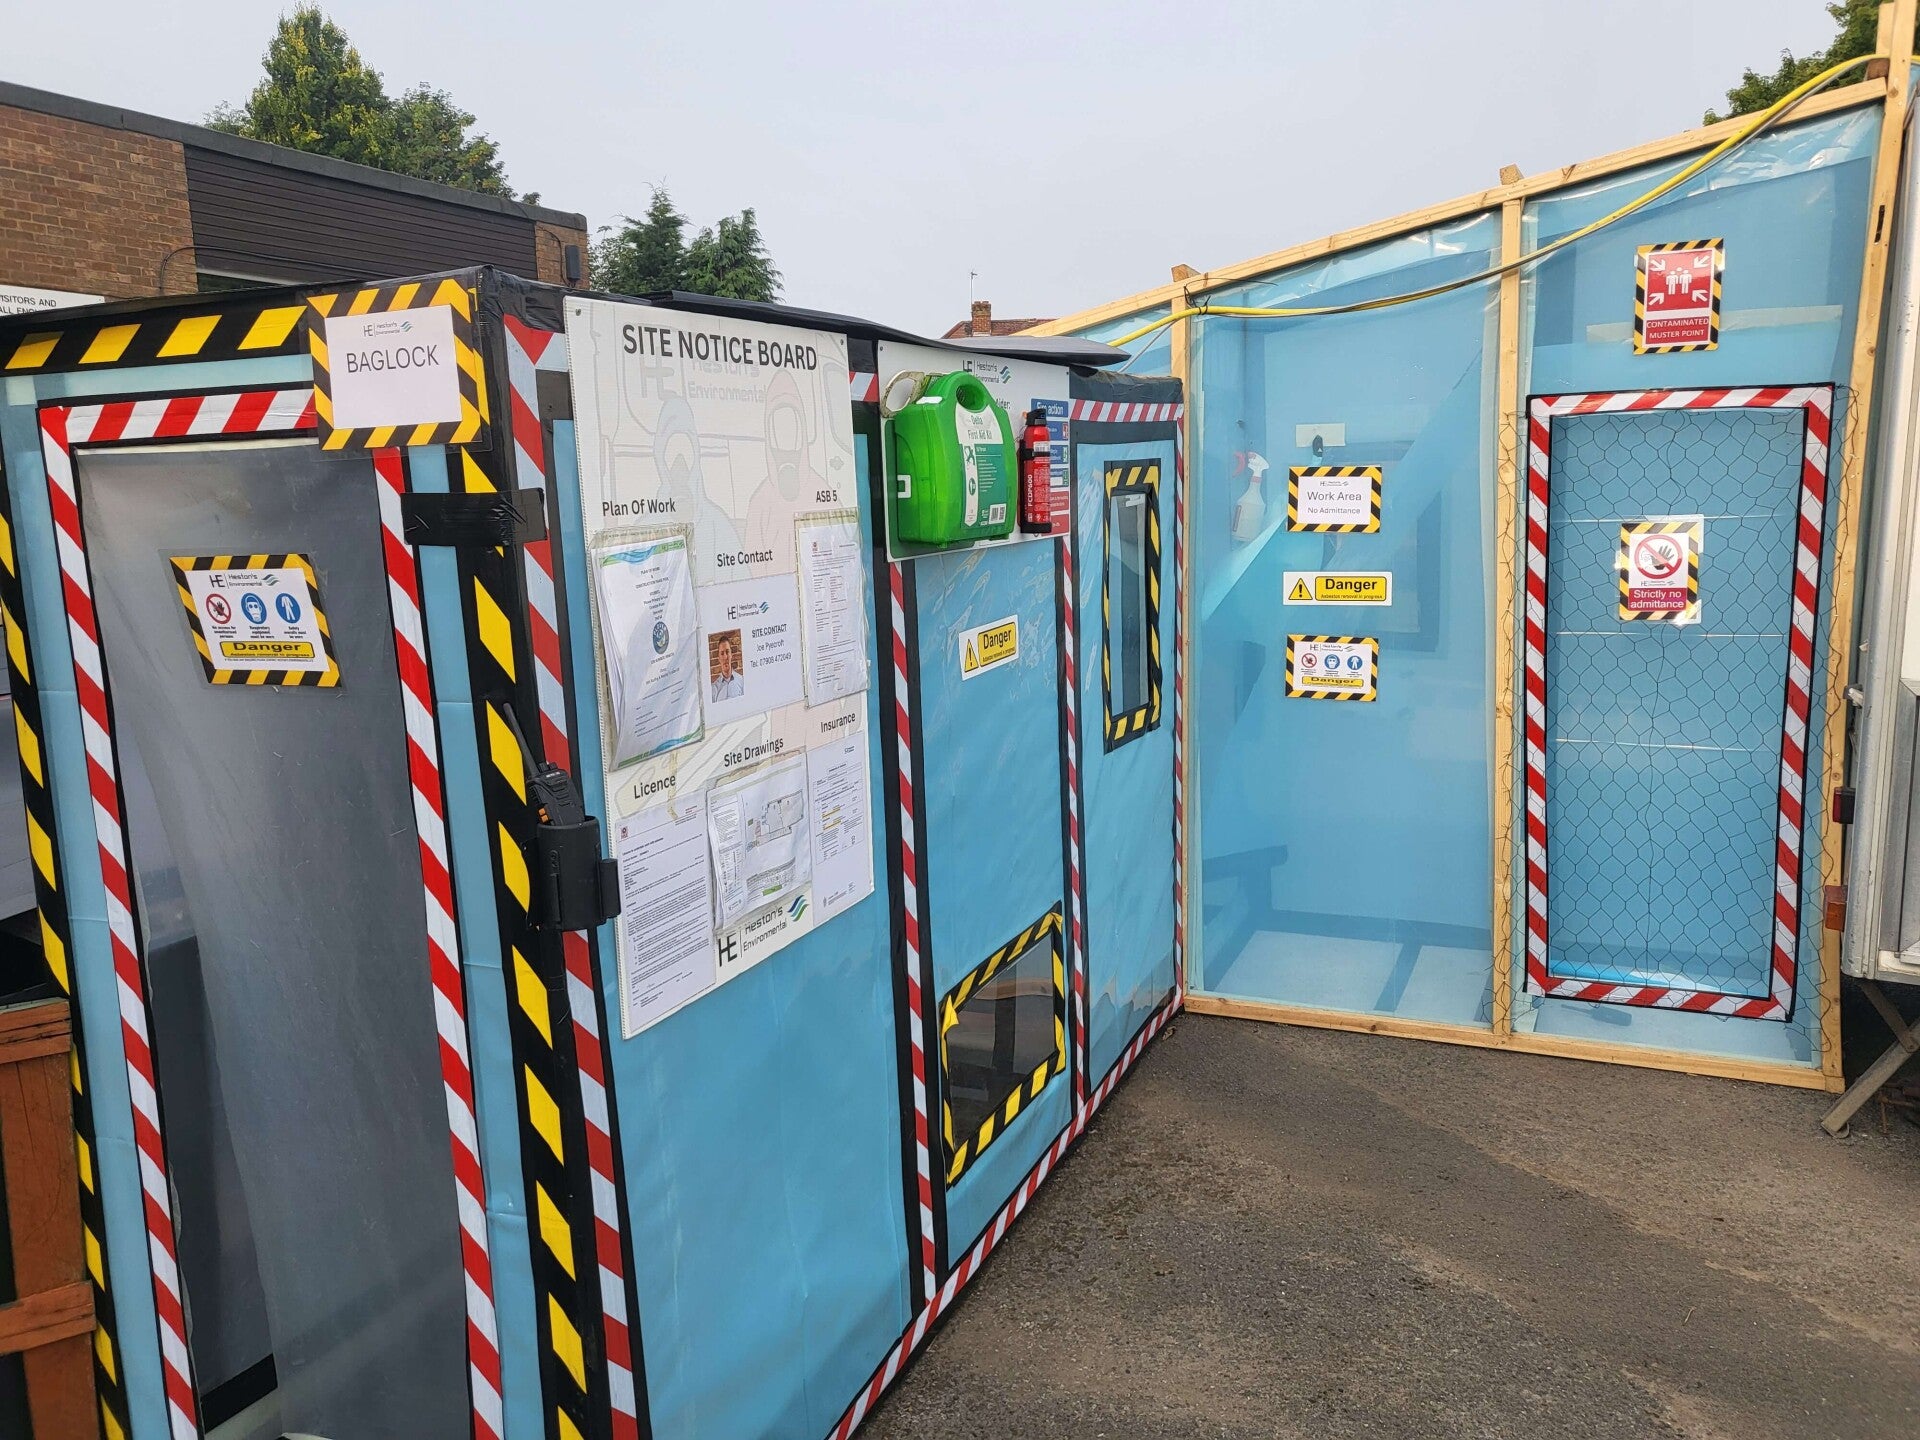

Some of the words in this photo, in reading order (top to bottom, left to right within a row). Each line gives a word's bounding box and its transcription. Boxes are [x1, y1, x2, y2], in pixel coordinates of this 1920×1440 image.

[39, 298, 56, 307] AND
[1646, 318, 1709, 328] CONTAMINATED
[1649, 330, 1680, 338] MUSTER
[622, 324, 673, 357] SITE
[678, 330, 754, 365] NOTICE
[758, 340, 817, 370] BOARD
[346, 344, 439, 373] BAGLOCK
[1048, 404, 1064, 415] action
[816, 490, 832, 503] ASB
[832, 490, 838, 502] 5
[1307, 492, 1334, 500] Work
[1337, 492, 1362, 500] Area
[602, 501, 628, 516] Plan
[632, 500, 645, 514] Of
[648, 498, 676, 514] Work
[717, 553, 736, 567] Site
[738, 549, 773, 564] Contact
[209, 574, 226, 588] HE
[228, 572, 258, 580] Heston's
[1326, 578, 1378, 592] Danger
[1634, 590, 1666, 600] Strictly
[1630, 600, 1684, 609] admittance
[752, 627, 764, 638] SITE
[764, 624, 787, 636] CONTACT
[234, 642, 300, 652] Danger
[983, 630, 1012, 650] Danger
[820, 712, 856, 733] Insurance
[724, 751, 742, 768] Site
[744, 738, 784, 760] Drawings
[634, 774, 676, 800] Licence
[744, 905, 784, 935] Heston's
[743, 920, 787, 952] Environmental
